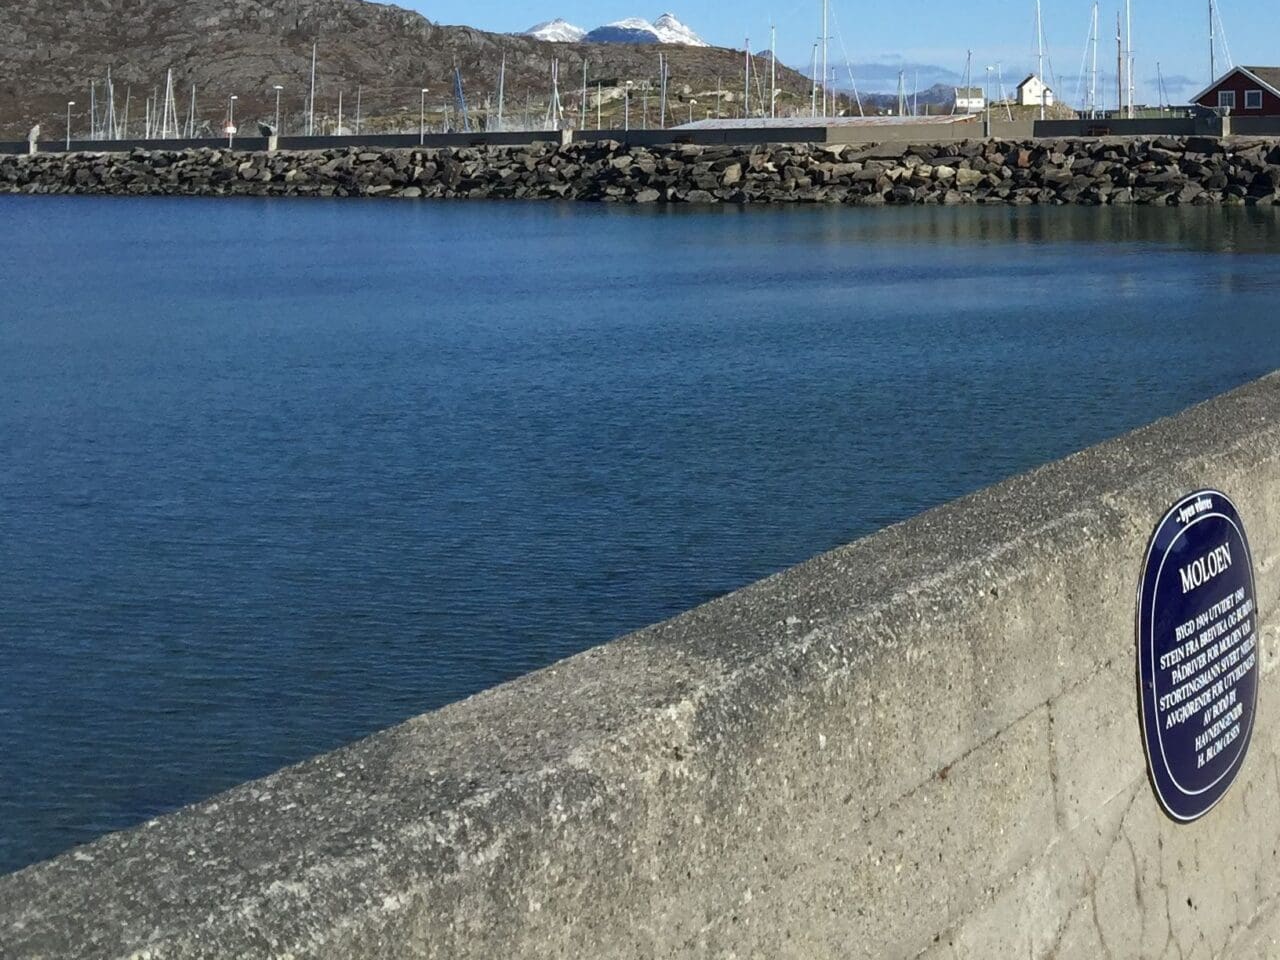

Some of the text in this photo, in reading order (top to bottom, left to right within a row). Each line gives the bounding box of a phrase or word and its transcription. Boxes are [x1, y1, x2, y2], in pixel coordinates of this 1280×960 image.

[1179, 542, 1232, 594] MOLOEN
[1160, 645, 1185, 670] STEIN
[1185, 638, 1200, 657] FRA
[1199, 618, 1228, 648] BREIVIKA
[1227, 611, 1237, 628] OG
[1175, 620, 1195, 642] BYGD
[1209, 593, 1234, 621] UTVIDET
[1160, 661, 1221, 712] STORTINGSMANN
[1220, 647, 1241, 673] SIVERT
[1171, 652, 1207, 685] PÅDRIVER
[1206, 643, 1220, 663] FOR
[1219, 627, 1242, 654] MOLOEN
[1166, 652, 1256, 730] AVGJØRENDE FOR UTVIKLINGEN
[1203, 708, 1212, 727] AV
[1212, 694, 1229, 719] BODØ
[1197, 753, 1206, 769] H.
